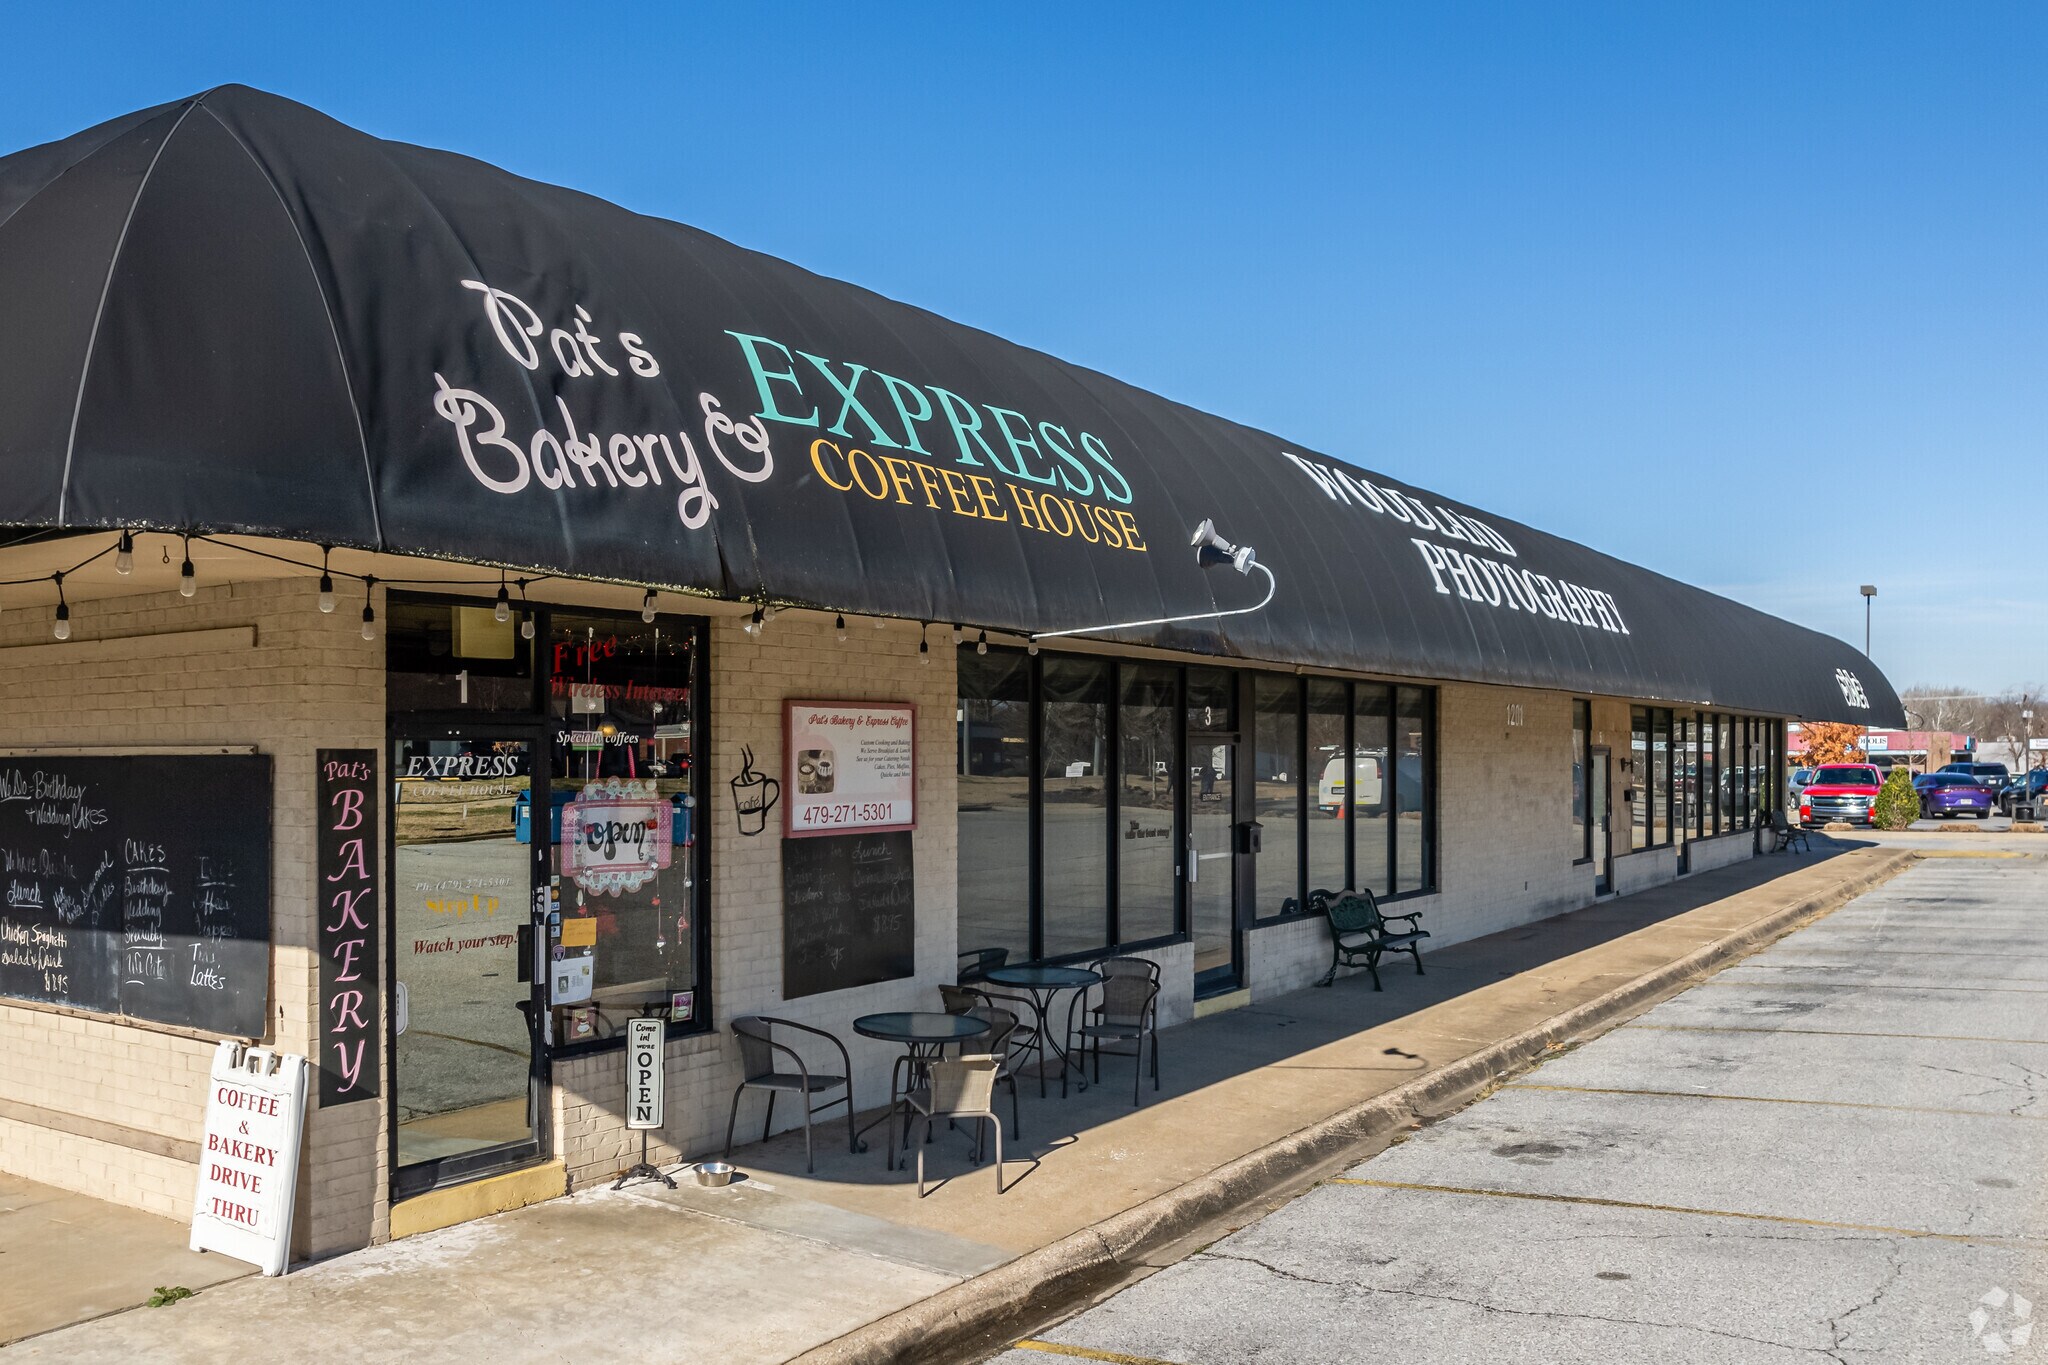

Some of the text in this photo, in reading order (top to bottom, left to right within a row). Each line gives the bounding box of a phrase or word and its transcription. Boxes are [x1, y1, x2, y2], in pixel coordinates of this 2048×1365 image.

[724, 329, 1133, 505] EXPRESS
[433, 372, 773, 530] Bakery &
[809, 438, 1148, 552] COFFEE HOUSE
[1281, 451, 1518, 558] WOODLAND
[1410, 537, 1631, 635] PHOTOGRAPHY
[554, 635, 618, 674] Free
[455, 669, 468, 704] 1
[550, 676, 690, 702] Wireless Internet
[830, 715, 856, 730] Bakery
[856, 716, 863, 725] &
[865, 715, 889, 728] Express
[890, 715, 909, 728] Coffee
[1205, 706, 1212, 726] 3
[1506, 703, 1524, 727] 1201
[556, 730, 639, 746] Specialty coffees
[323, 759, 371, 781] Pat's
[405, 755, 519, 778] EXPRESS
[33, 770, 87, 806] Birthday
[413, 783, 513, 796] COFFEE HOUSE
[803, 802, 893, 824] 479-271-5301
[587, 820, 645, 860] open
[7, 879, 43, 907] Lunch
[326, 788, 371, 1093] BAKERY
[414, 930, 519, 955] Watch your step!
[635, 1023, 656, 1032] Come
[639, 1033, 650, 1042] in!
[636, 1052, 652, 1121] OPEN
[218, 1087, 280, 1117] COFFEE
[238, 1120, 249, 1135] &
[207, 1133, 279, 1167] BAKERY
[210, 1163, 262, 1194] DRIVE
[212, 1196, 259, 1227] THRU
